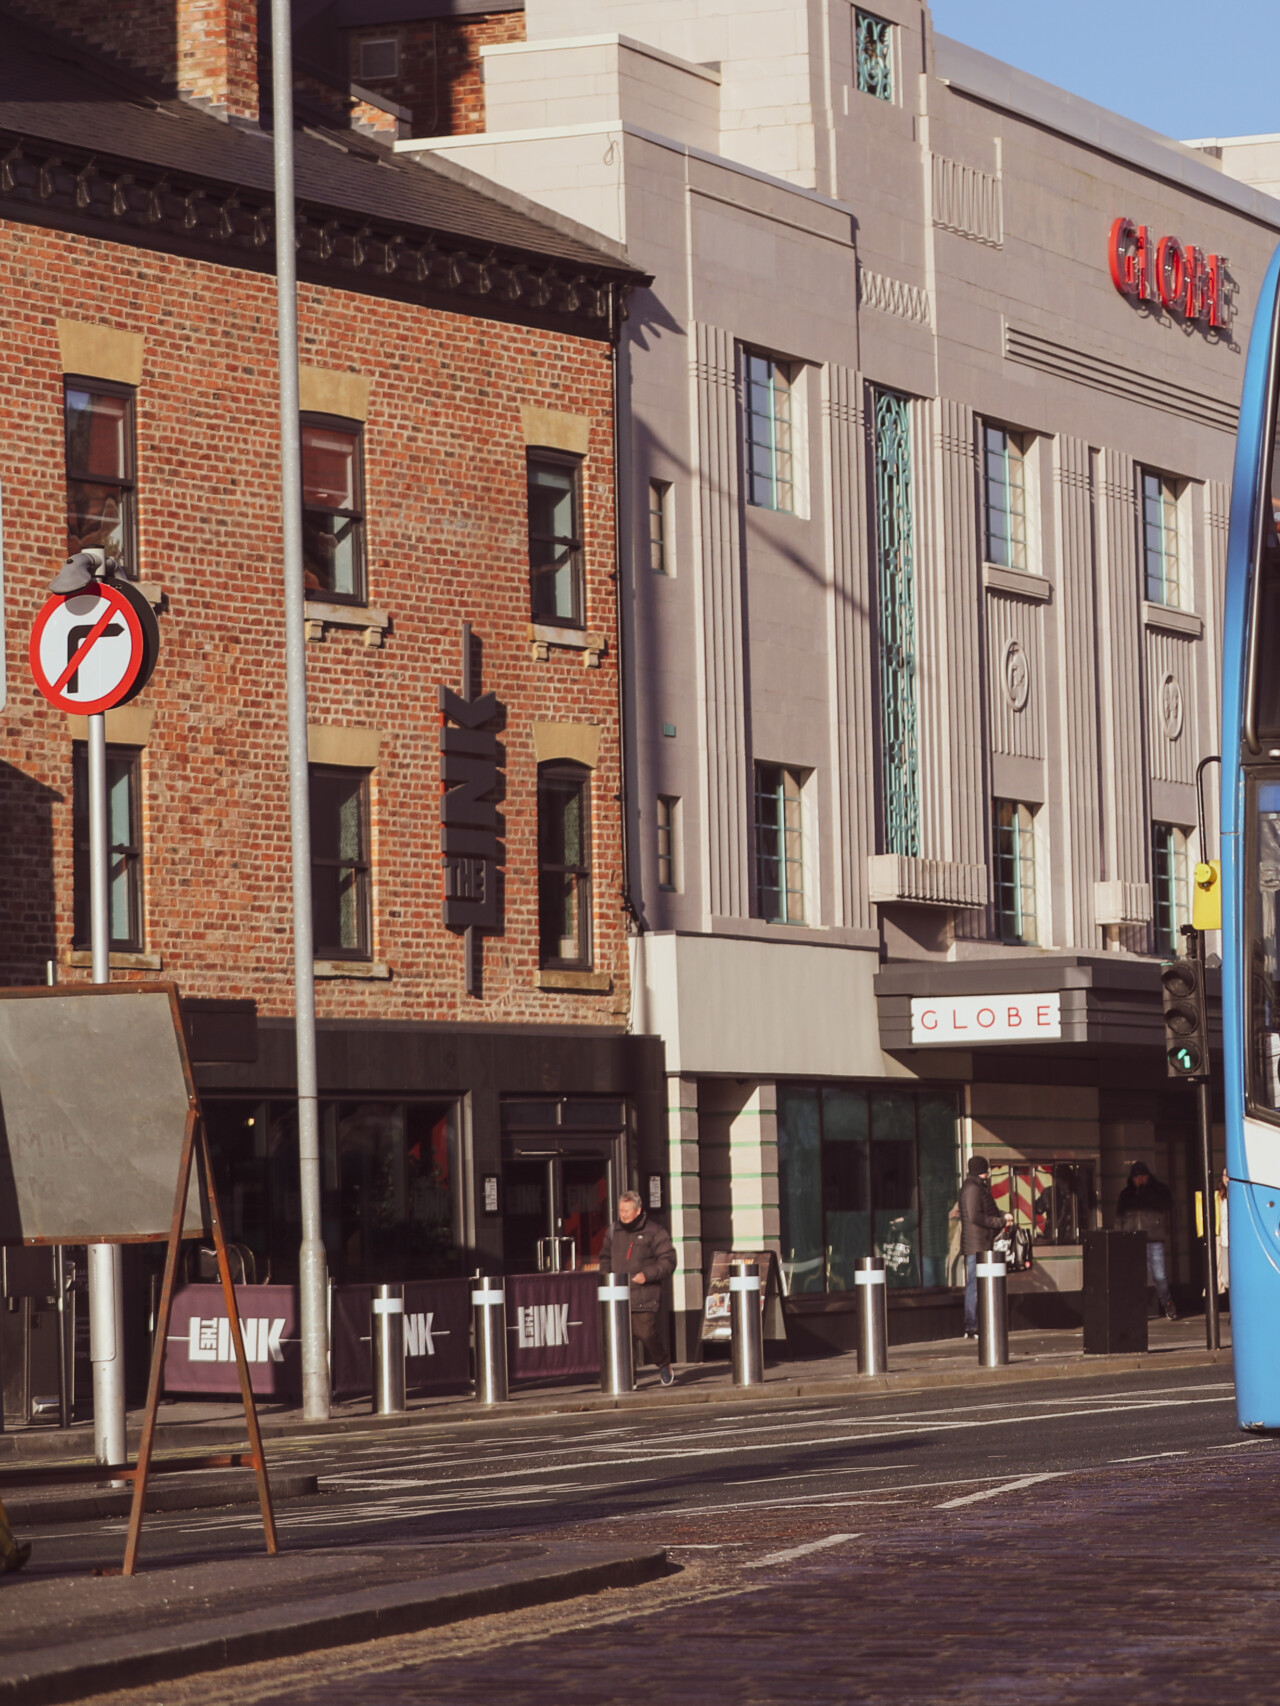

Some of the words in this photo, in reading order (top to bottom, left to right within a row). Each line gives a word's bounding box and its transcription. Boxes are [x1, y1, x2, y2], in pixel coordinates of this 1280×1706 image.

[1108, 217, 1231, 328] GLOBE
[439, 684, 499, 927] LINK
[921, 1004, 1052, 1030] GLOBE
[188, 1316, 286, 1362] LINK
[200, 1317, 218, 1350] THE
[518, 1303, 569, 1348] LINK
[525, 1306, 534, 1338] THE
